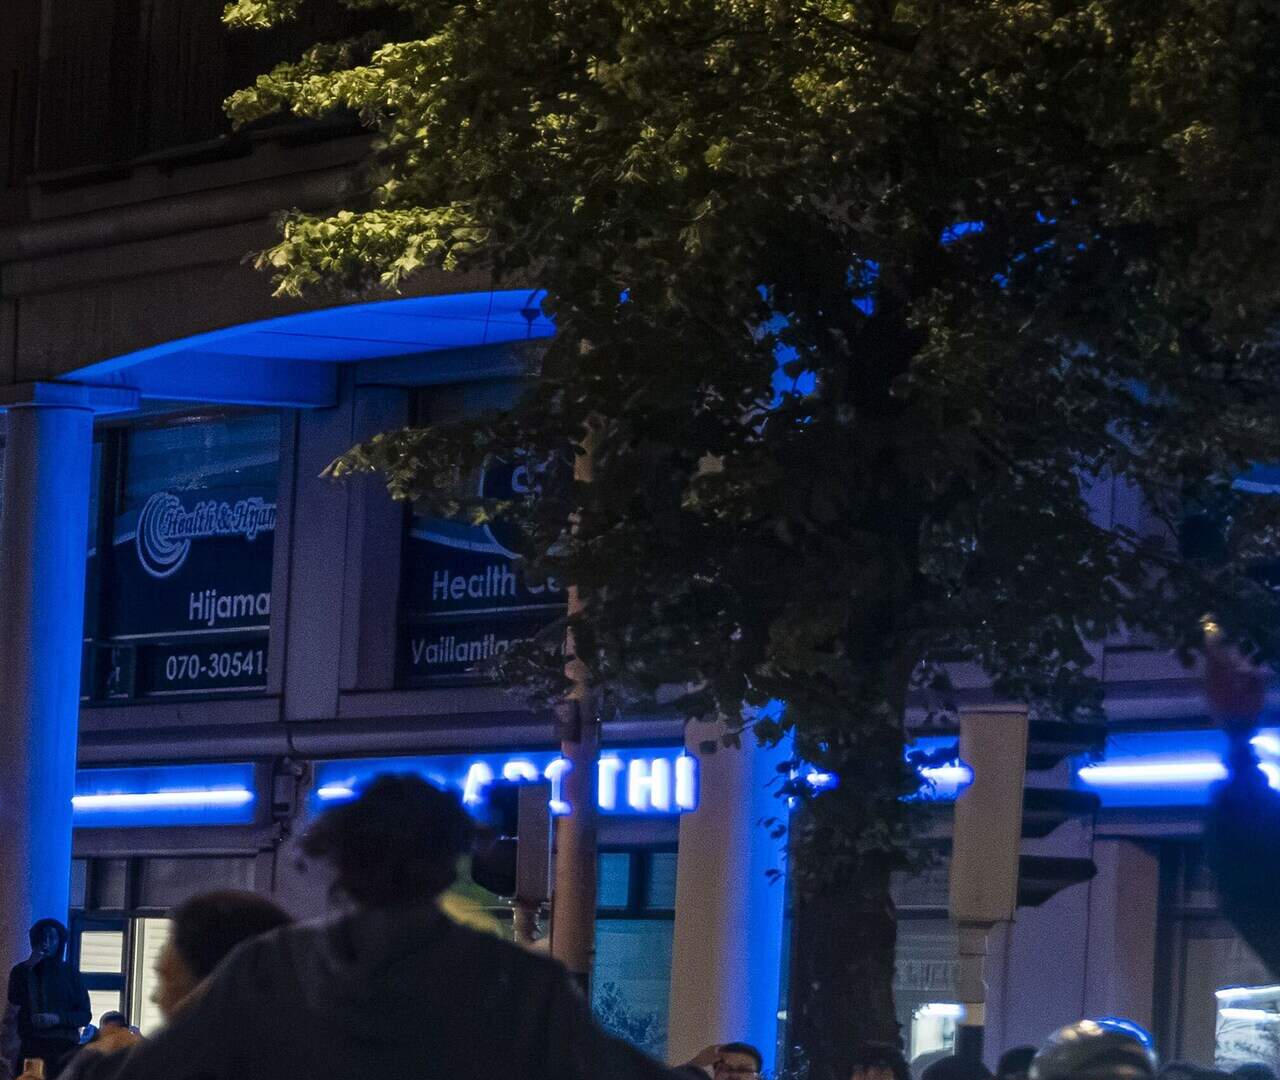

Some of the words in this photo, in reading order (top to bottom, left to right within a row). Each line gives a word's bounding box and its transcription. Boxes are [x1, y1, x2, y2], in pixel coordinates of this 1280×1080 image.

[433, 565, 516, 600] Health
[189, 589, 271, 626] Hijama
[166, 650, 267, 680] 070-30541
